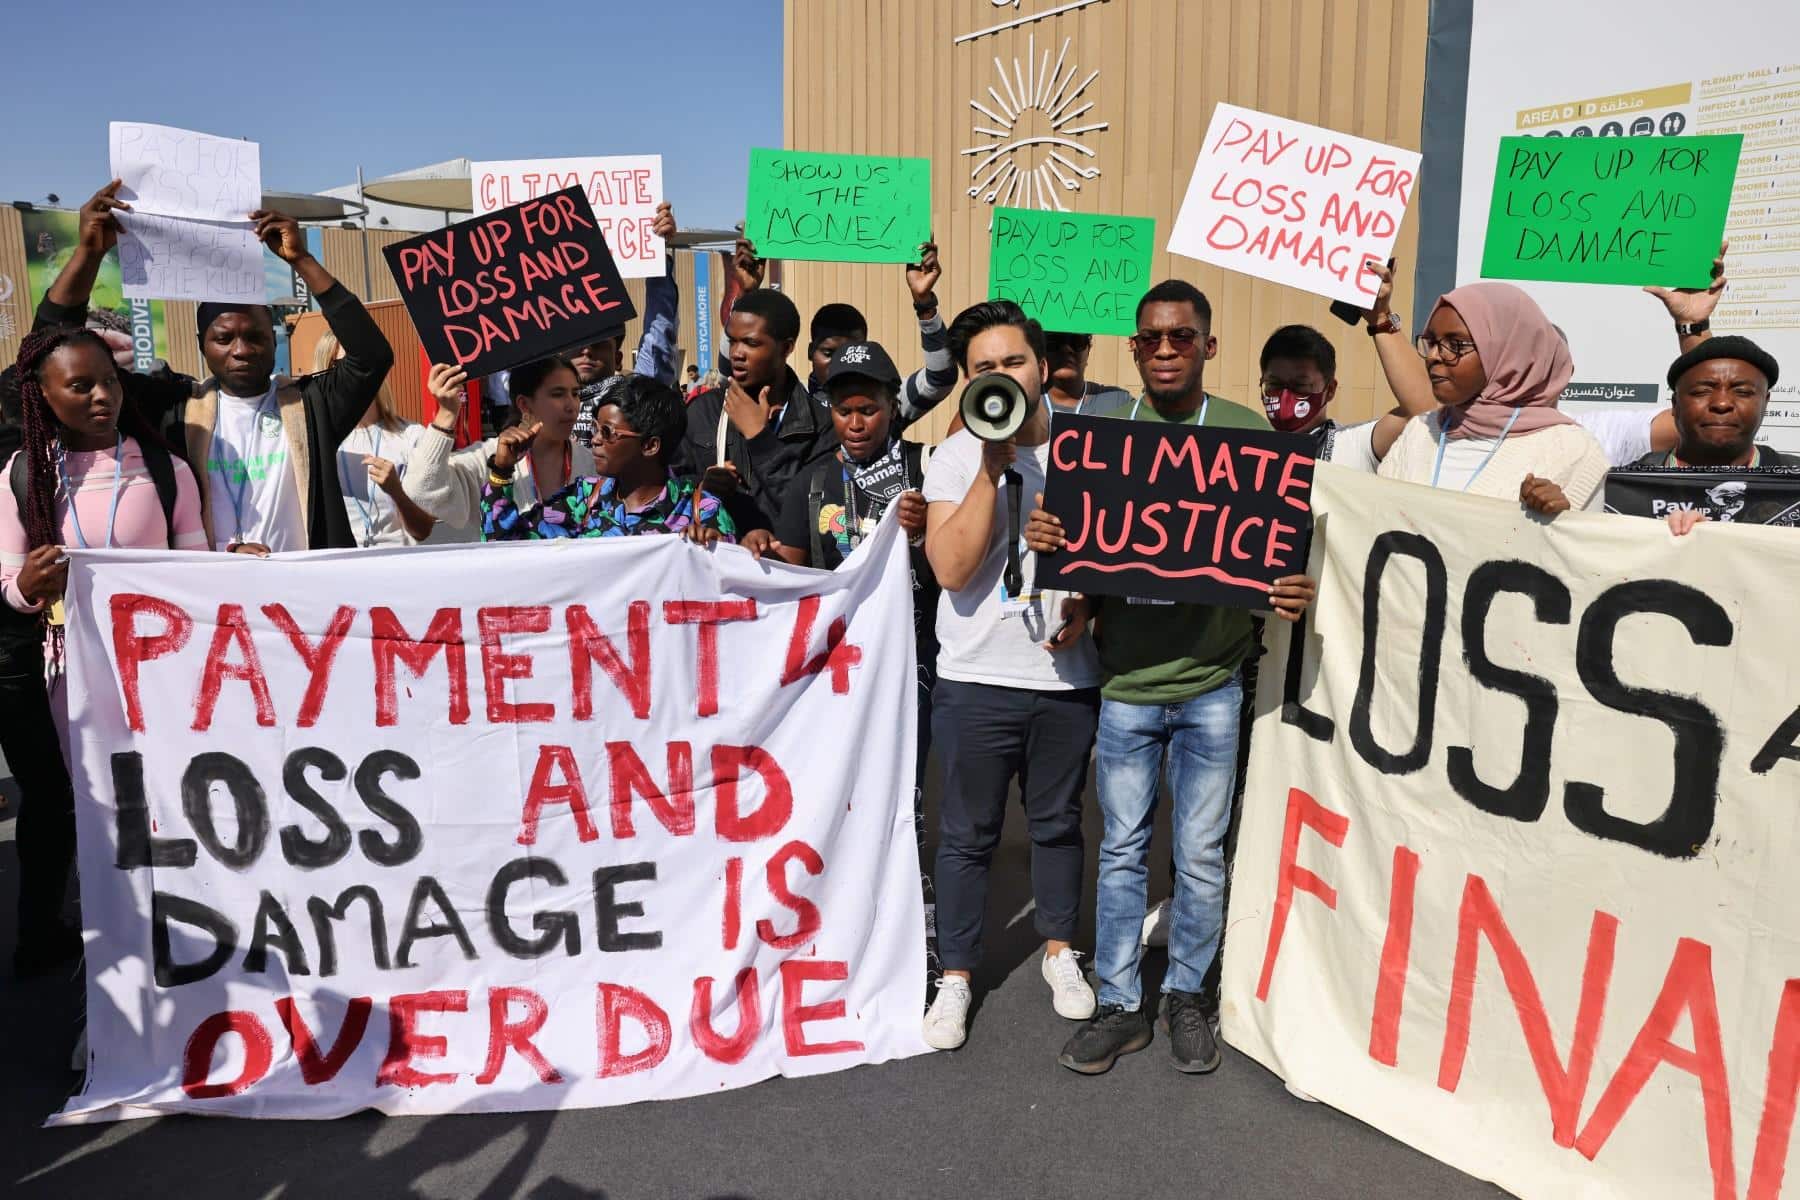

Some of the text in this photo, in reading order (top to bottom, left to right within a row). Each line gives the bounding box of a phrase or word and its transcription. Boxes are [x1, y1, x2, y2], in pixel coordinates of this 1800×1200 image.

[1701, 73, 1744, 87] PLENARY
[1747, 68, 1771, 79] HALL
[1521, 110, 1559, 126] AREA
[1563, 106, 1574, 119] D
[1585, 103, 1596, 116] D
[119, 125, 253, 183] PAY FOR
[770, 159, 890, 184] SHOW US
[1210, 117, 1414, 206] PAY UP FOR
[1508, 146, 1711, 181] PAY UP FOR
[767, 207, 897, 242] MONEY
[805, 186, 869, 207] THE
[1209, 172, 1396, 238] LOSS AND
[1506, 189, 1697, 223] LOSS AND
[400, 230, 455, 291] PAY
[469, 219, 512, 265] UP
[519, 195, 593, 245] FOR
[996, 216, 1136, 250] PAY UP FOR
[1206, 215, 1386, 297] DAMAGE
[1515, 227, 1673, 267] DAMAGE
[438, 242, 590, 318] LOSS AND
[995, 254, 1139, 285] LOSS AND
[442, 272, 622, 367] DAMAGE
[698, 285, 709, 352] SYCAMORE
[994, 291, 1134, 322] DAMAGE
[856, 463, 904, 490] Damag
[1052, 430, 1315, 512] CLIMATE
[1063, 491, 1297, 568] JUSTICE
[108, 593, 862, 732] PAYMENT 4
[1281, 530, 1734, 861] LOSS
[111, 741, 793, 871] LOSS AND
[151, 841, 824, 988] DAMAGE IS
[1256, 787, 1800, 1200] FINA
